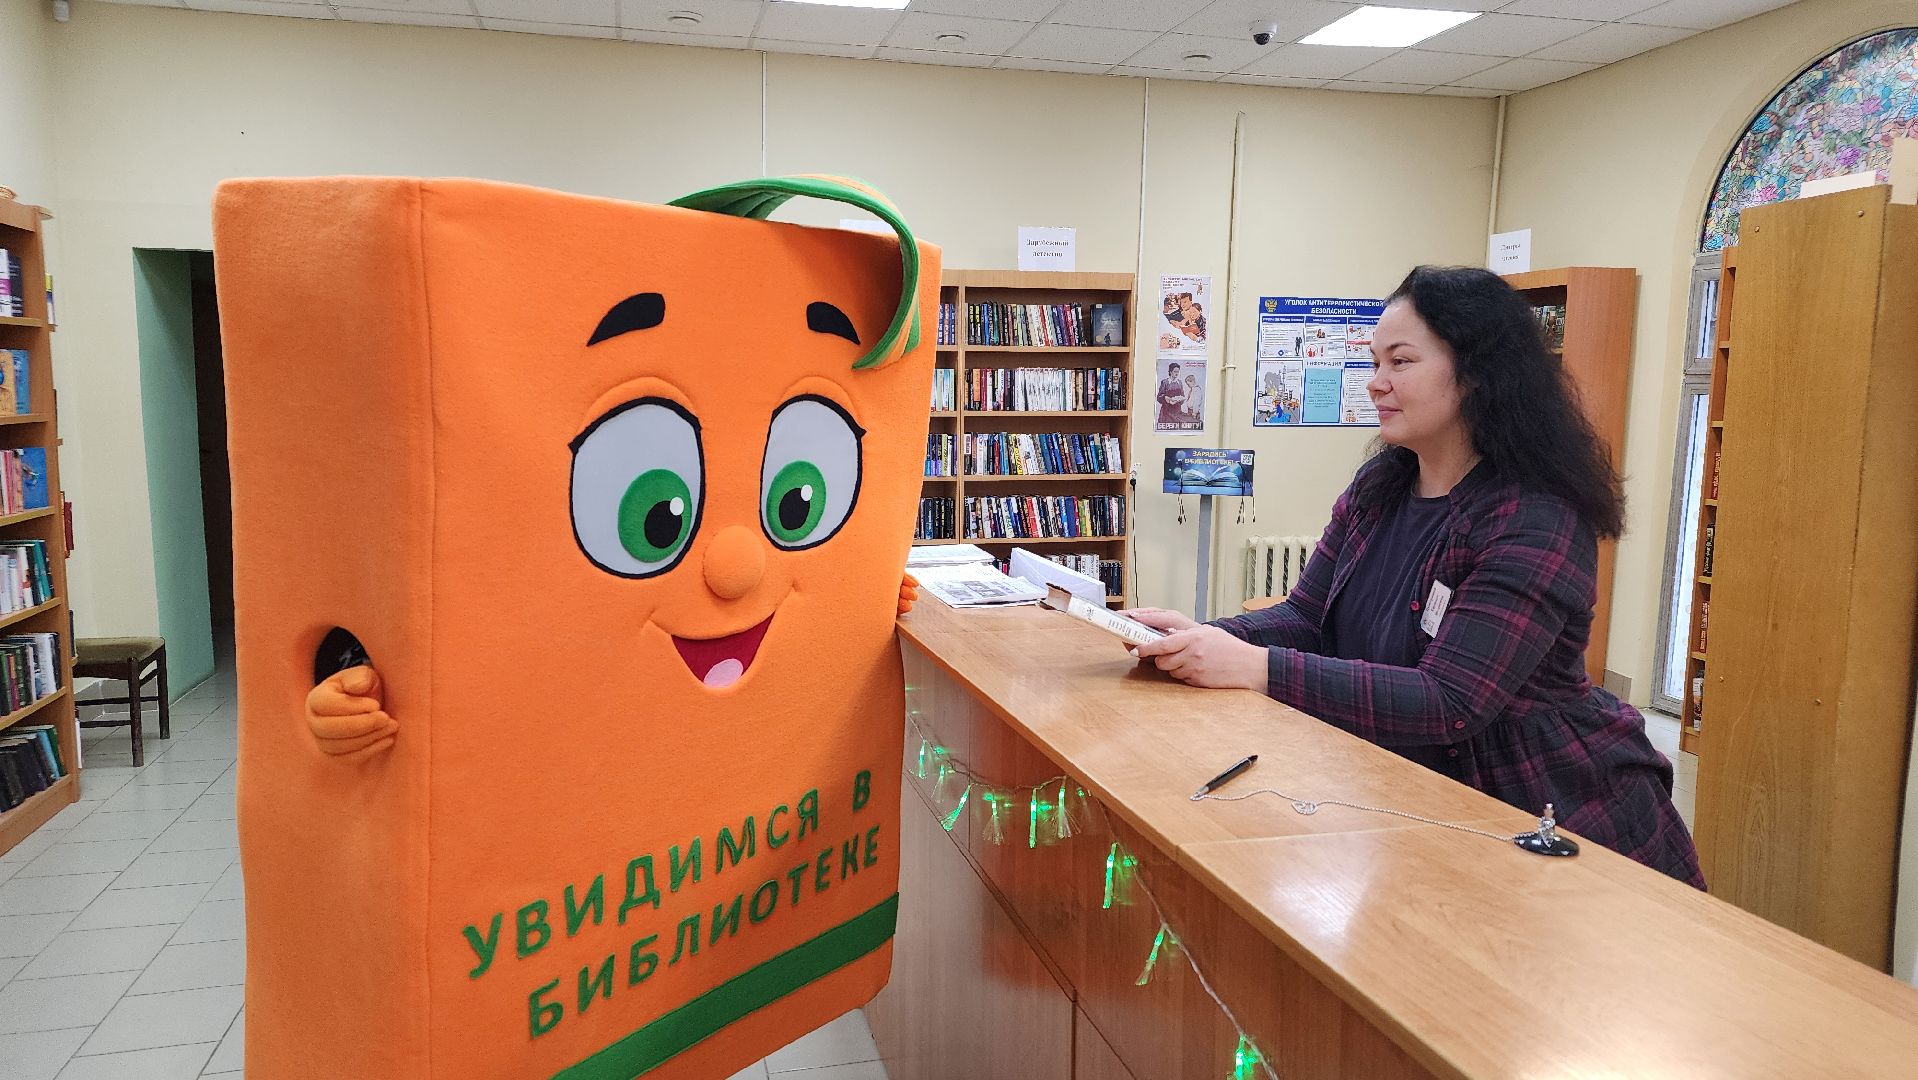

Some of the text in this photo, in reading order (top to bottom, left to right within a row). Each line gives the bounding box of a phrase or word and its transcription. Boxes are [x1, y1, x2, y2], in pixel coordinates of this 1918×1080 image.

[1311, 307, 1357, 315] БЕЗОПАСНОСТИ
[461, 769, 872, 980] УВИДИМСЯ В
[527, 824, 881, 1041] БИБЛИОТЕКЕ
